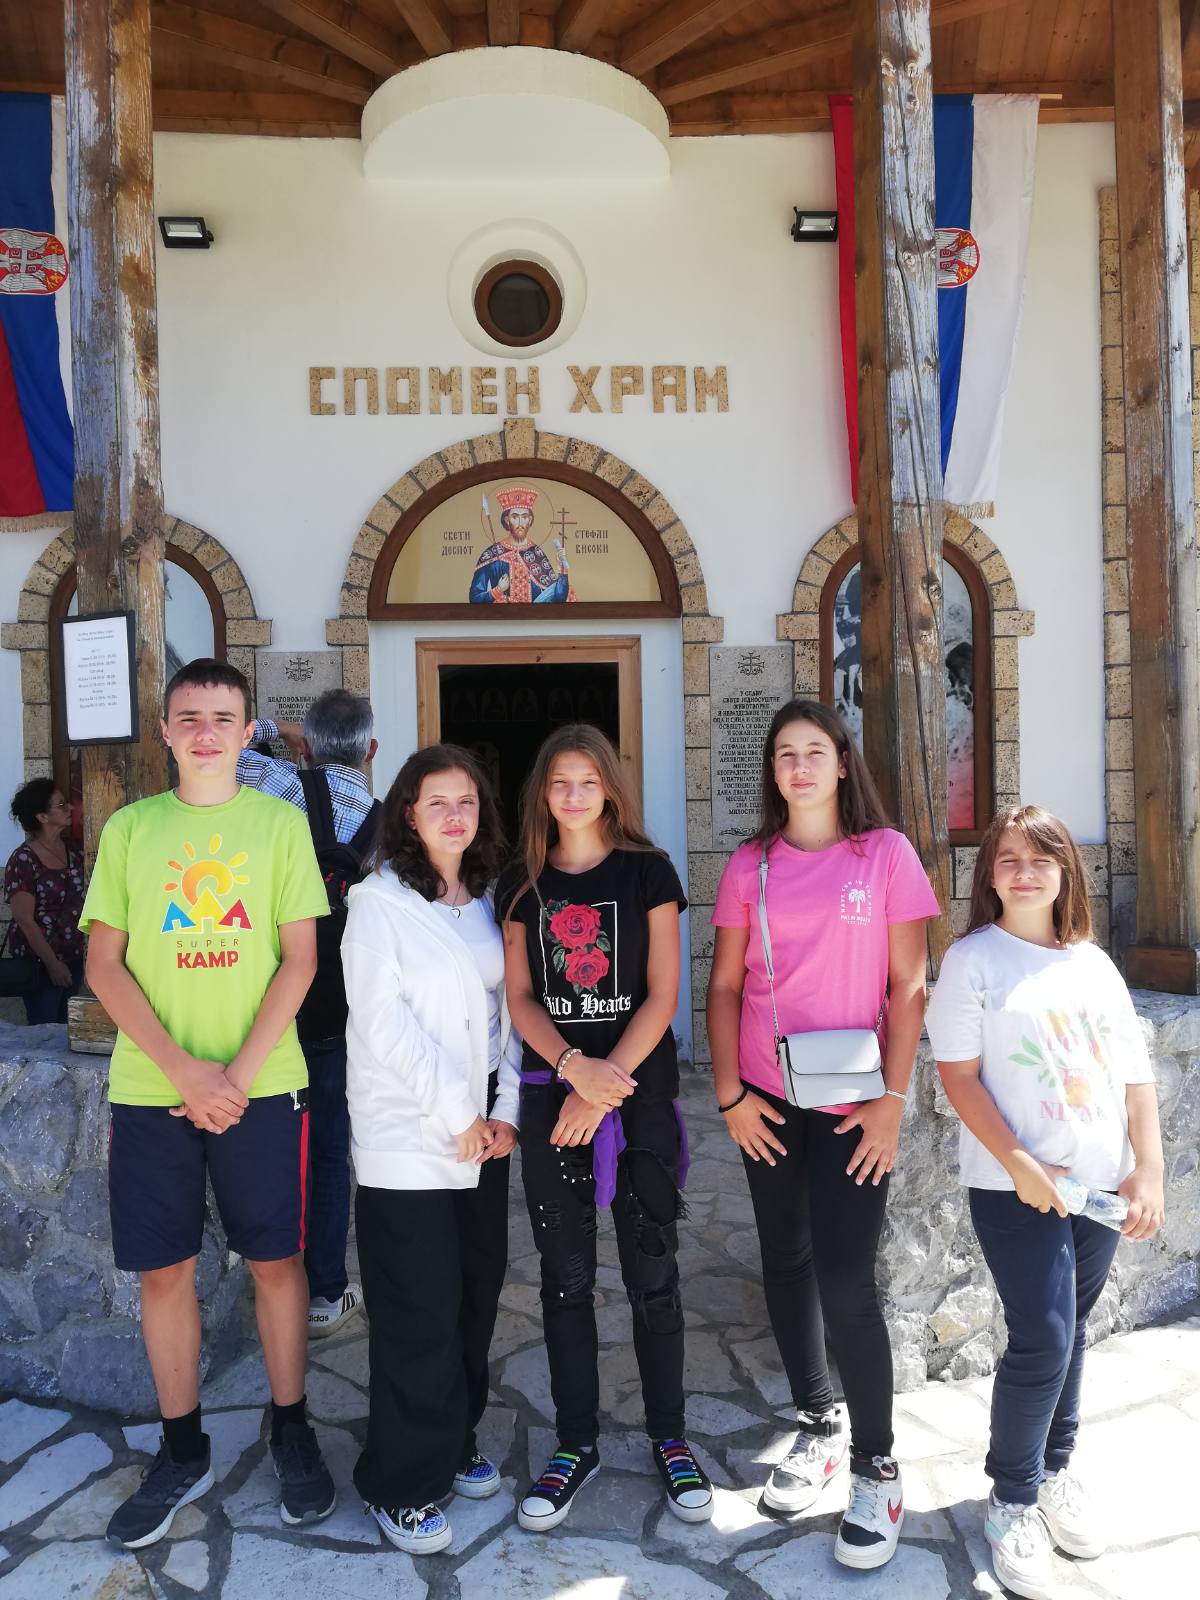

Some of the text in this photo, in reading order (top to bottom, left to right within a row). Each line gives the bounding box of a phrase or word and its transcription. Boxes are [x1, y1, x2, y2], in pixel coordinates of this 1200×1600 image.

[309, 365, 730, 415] СПОМЕН ХРАМ
[443, 531, 471, 541] СВЕТИ
[575, 529, 608, 540] СТЕФАН
[441, 545, 474, 557] ДЕСПОТ
[176, 938, 239, 948] SUPER
[177, 950, 239, 969] KAMP
[580, 993, 632, 1018] Hearts
